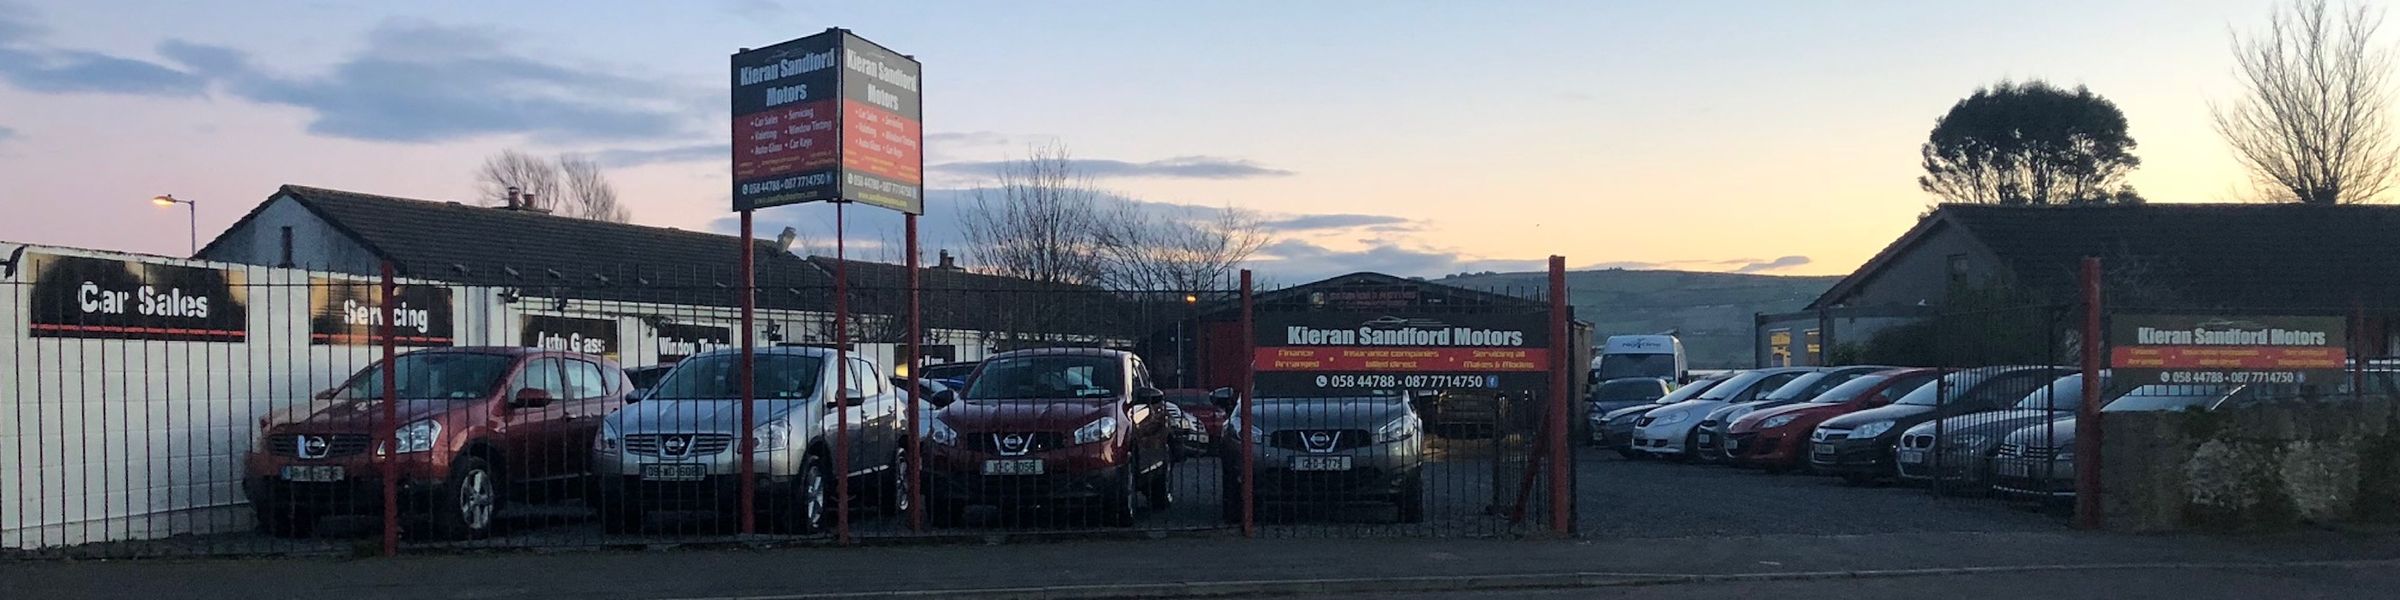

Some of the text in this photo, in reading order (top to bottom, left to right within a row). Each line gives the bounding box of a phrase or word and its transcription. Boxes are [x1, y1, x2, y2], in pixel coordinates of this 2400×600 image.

[740, 48, 834, 86] Kieran Sandford
[847, 49, 916, 92] Kieran Sandford
[766, 84, 807, 106] Motors
[868, 84, 898, 110] Motors
[78, 281, 208, 318] Car Sales
[344, 299, 428, 333] Servcing
[570, 332, 606, 354] Gass
[1288, 326, 1522, 346] Kieran Sandford Motors
[2138, 327, 2326, 346] Kieran Sandford Motors
[1274, 360, 1320, 368] Arranged
[1344, 350, 1389, 358] Insurance
[1472, 350, 1514, 358] Servicing
[1331, 375, 1354, 388] 058
[1357, 375, 1394, 388] 44788
[1404, 376, 1428, 388] 087
[1431, 376, 1483, 388] 7714750
[2172, 371, 2294, 382] 058 44788 087 7714750
